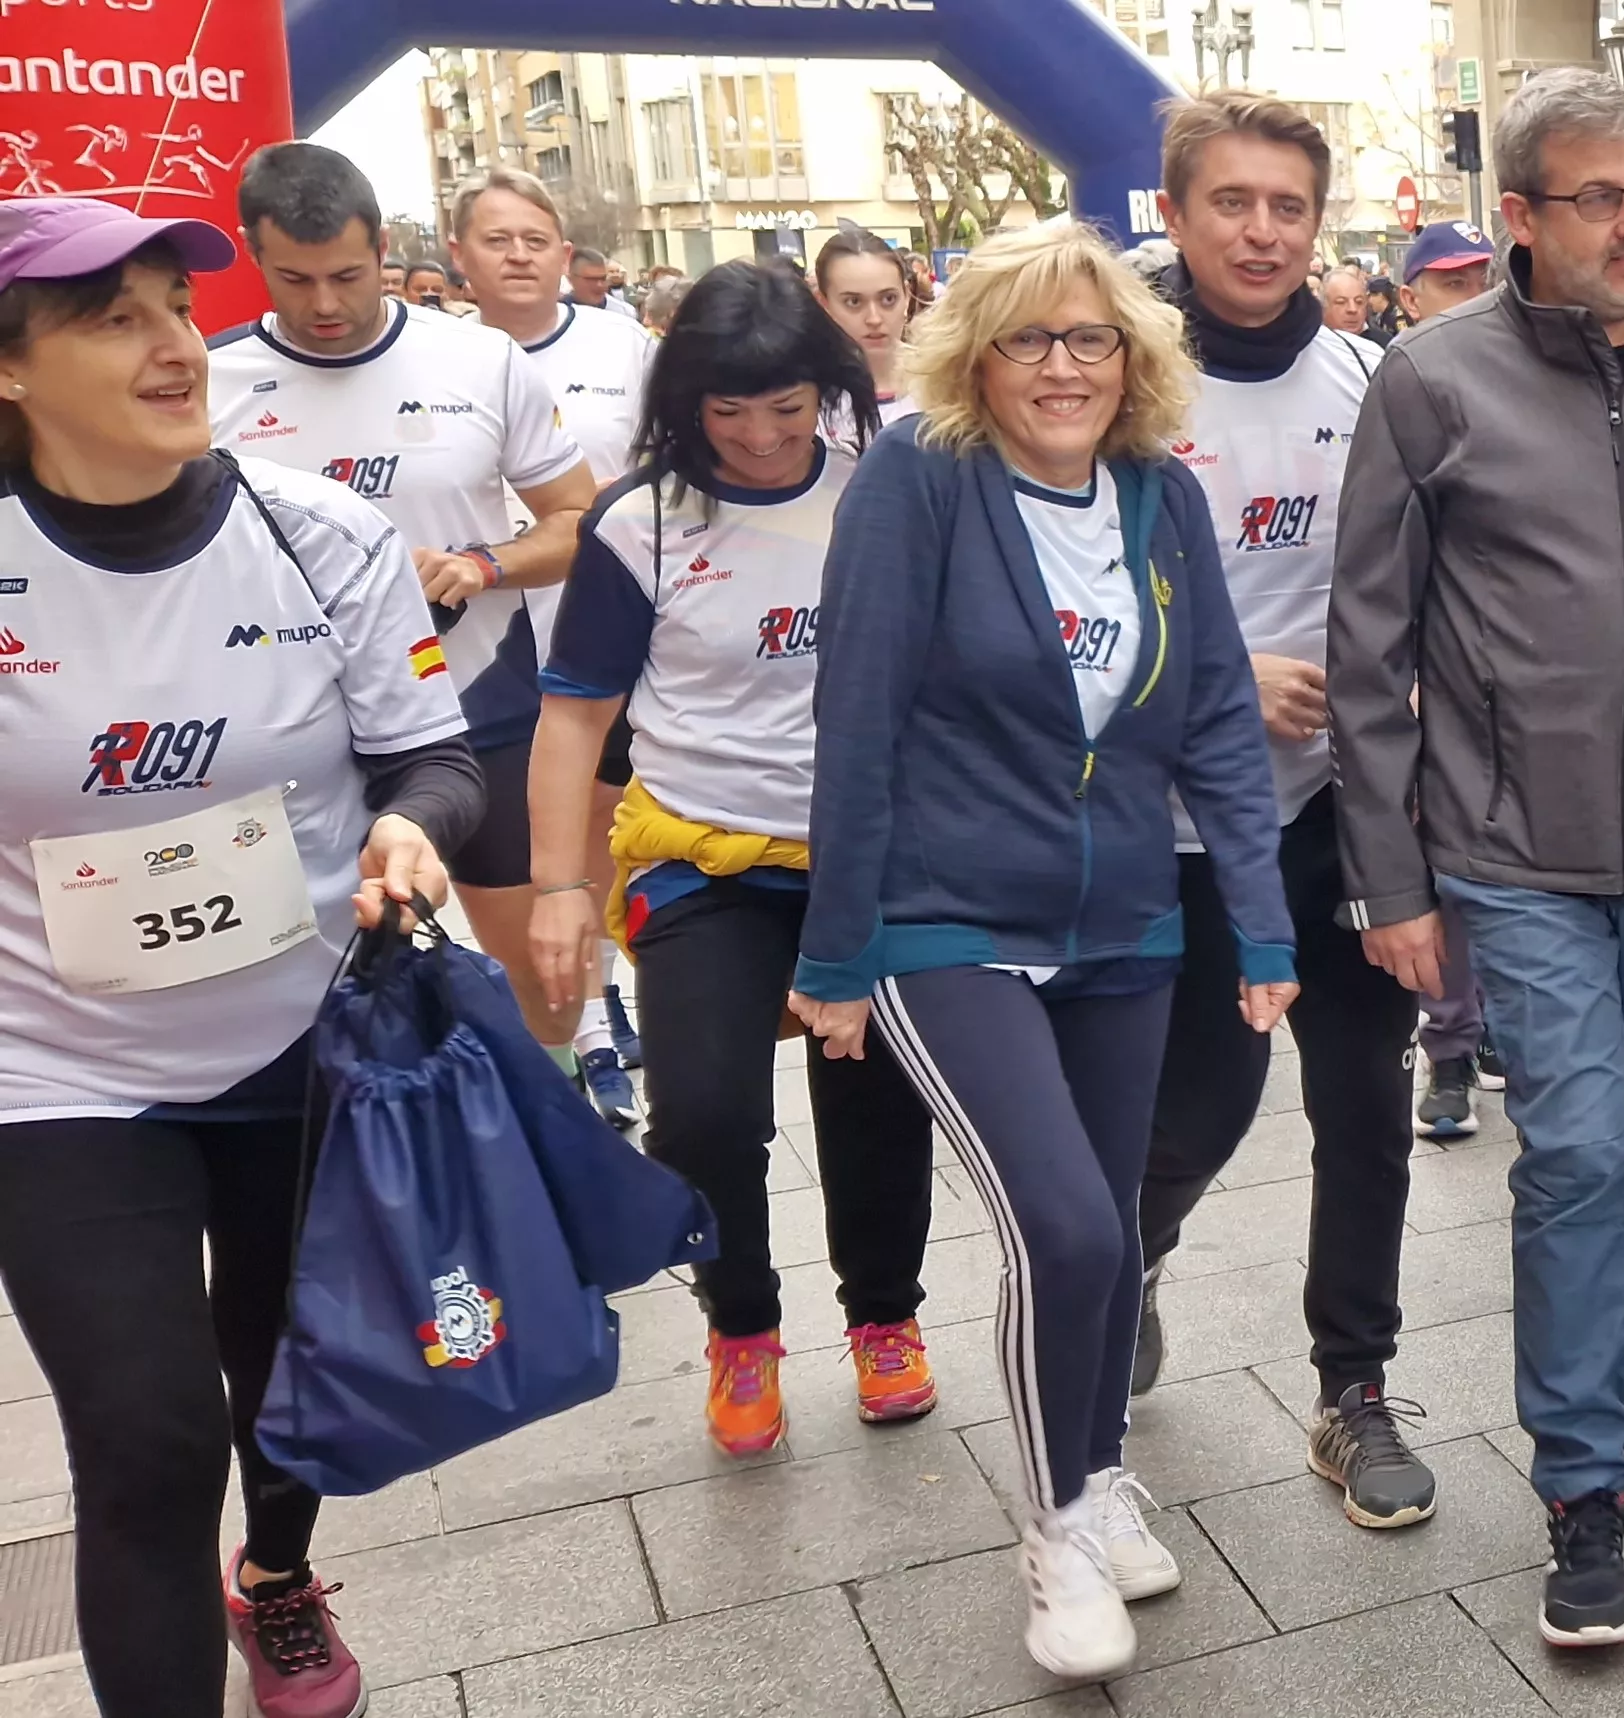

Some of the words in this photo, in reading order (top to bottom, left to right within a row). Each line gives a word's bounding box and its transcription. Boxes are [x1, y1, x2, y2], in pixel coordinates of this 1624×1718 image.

[430, 401, 473, 416] mupol
[238, 425, 299, 443] Santander
[672, 570, 733, 590] Santander
[276, 622, 334, 645] mupo
[81, 717, 228, 793] R091
[97, 780, 205, 796] SOLIDARIA
[60, 876, 119, 891] Santander
[132, 894, 243, 951] 352
